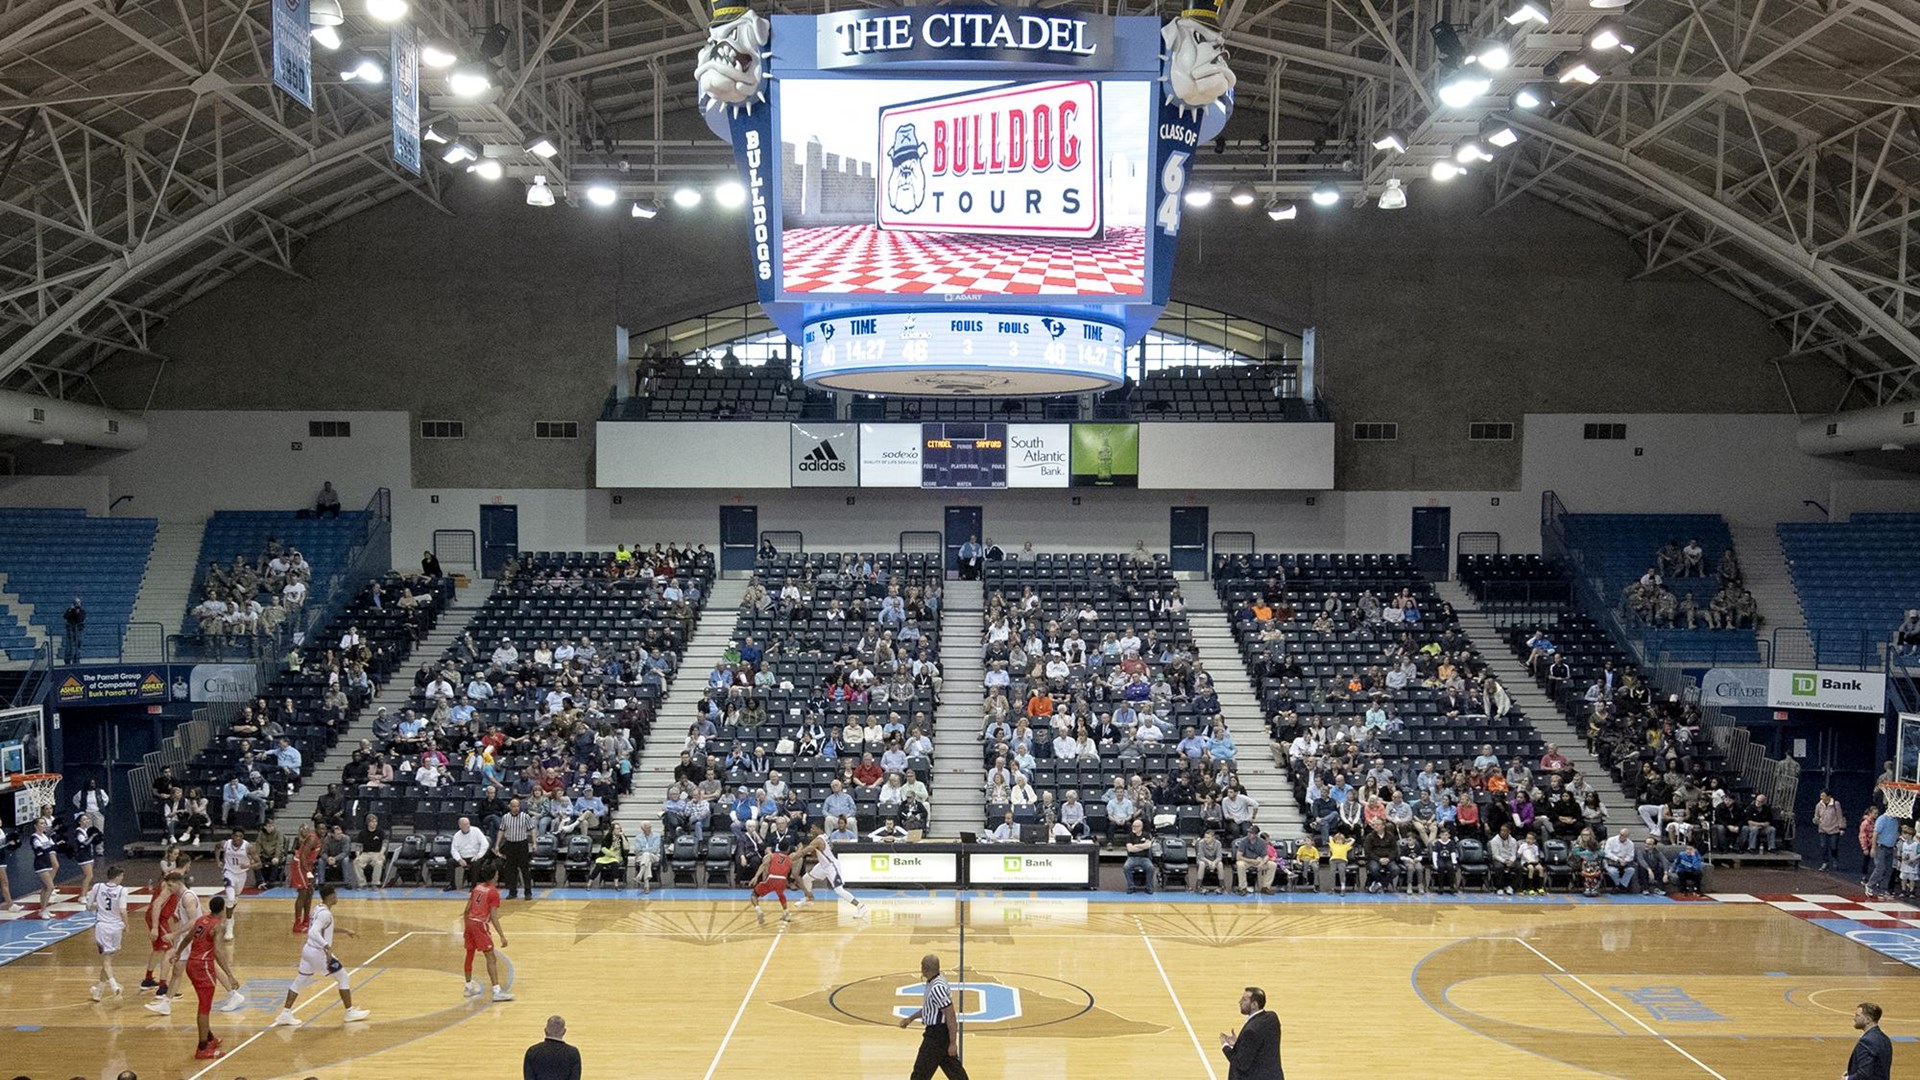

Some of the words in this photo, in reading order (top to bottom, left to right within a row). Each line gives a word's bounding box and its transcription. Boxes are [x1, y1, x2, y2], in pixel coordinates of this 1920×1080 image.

[836, 15, 914, 53] THE
[922, 13, 1097, 54] CITADEL
[933, 100, 1080, 176] BULLDOG
[1160, 124, 1184, 141] CLASS
[1184, 129, 1197, 146] OF
[745, 130, 771, 280] BULLDOGS
[933, 188, 1080, 214] TOURS
[850, 319, 877, 335] TIME
[951, 320, 983, 332] FOULS
[999, 322, 1029, 334] FOULS
[1083, 323, 1103, 341] TIME
[962, 338, 973, 354] 3
[1009, 340, 1018, 356] 3
[1044, 342, 1066, 365] 40
[927, 440, 952, 448] CITADEL
[976, 440, 1002, 448] SAMFORD
[1011, 436, 1044, 448] South
[882, 448, 918, 459] sodexo
[1024, 450, 1066, 462] Atlantic
[799, 460, 846, 471] adidas
[120, 672, 141, 680] Group
[97, 680, 137, 689] Companies
[1716, 682, 1767, 697] CITADEL
[1793, 675, 1816, 694] TD
[1822, 678, 1862, 691] Bank
[1776, 699, 1804, 707] America's
[1822, 702, 1857, 710] Convenient
[893, 857, 922, 866] Bank
[1025, 859, 1053, 867] Bank
[105, 897, 111, 911] 3
